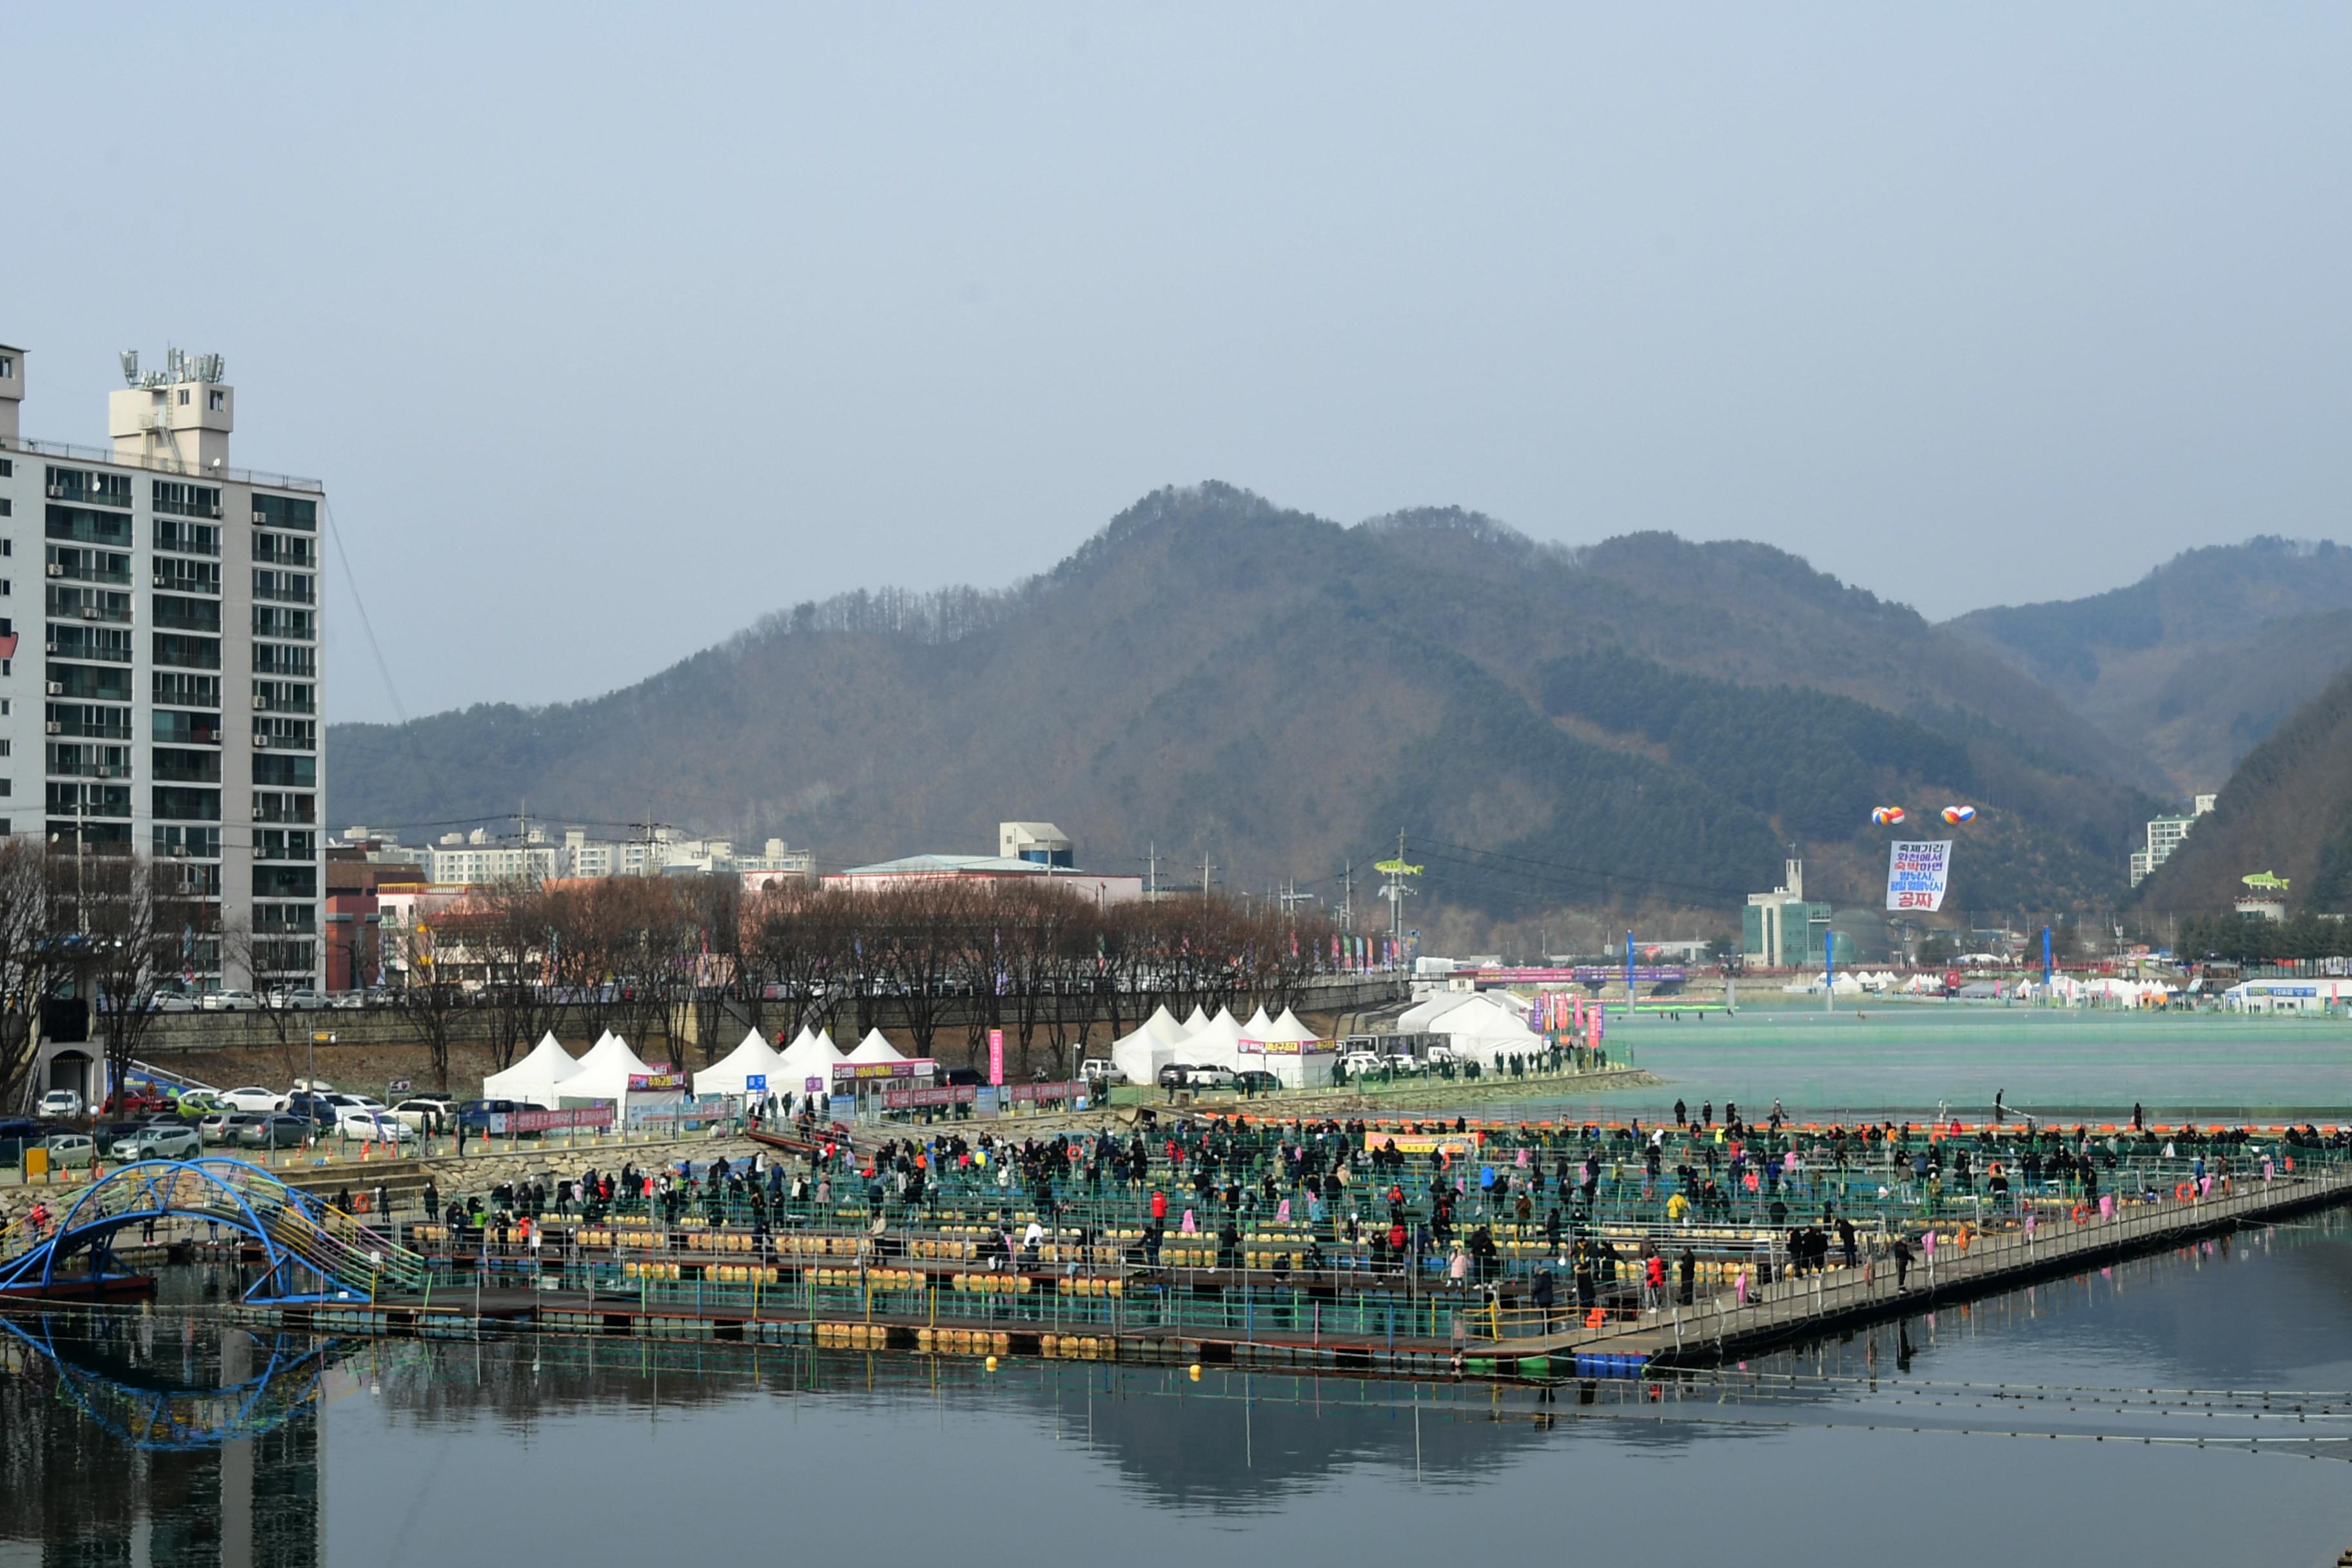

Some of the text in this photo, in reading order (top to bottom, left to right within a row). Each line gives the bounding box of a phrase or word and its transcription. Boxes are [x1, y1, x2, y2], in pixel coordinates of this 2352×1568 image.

[1899, 843, 1944, 852] 축제기간
[1897, 852, 1942, 861] 화천에서
[1894, 861, 1943, 871] 숙박하면
[1899, 892, 1933, 908] 공짜
